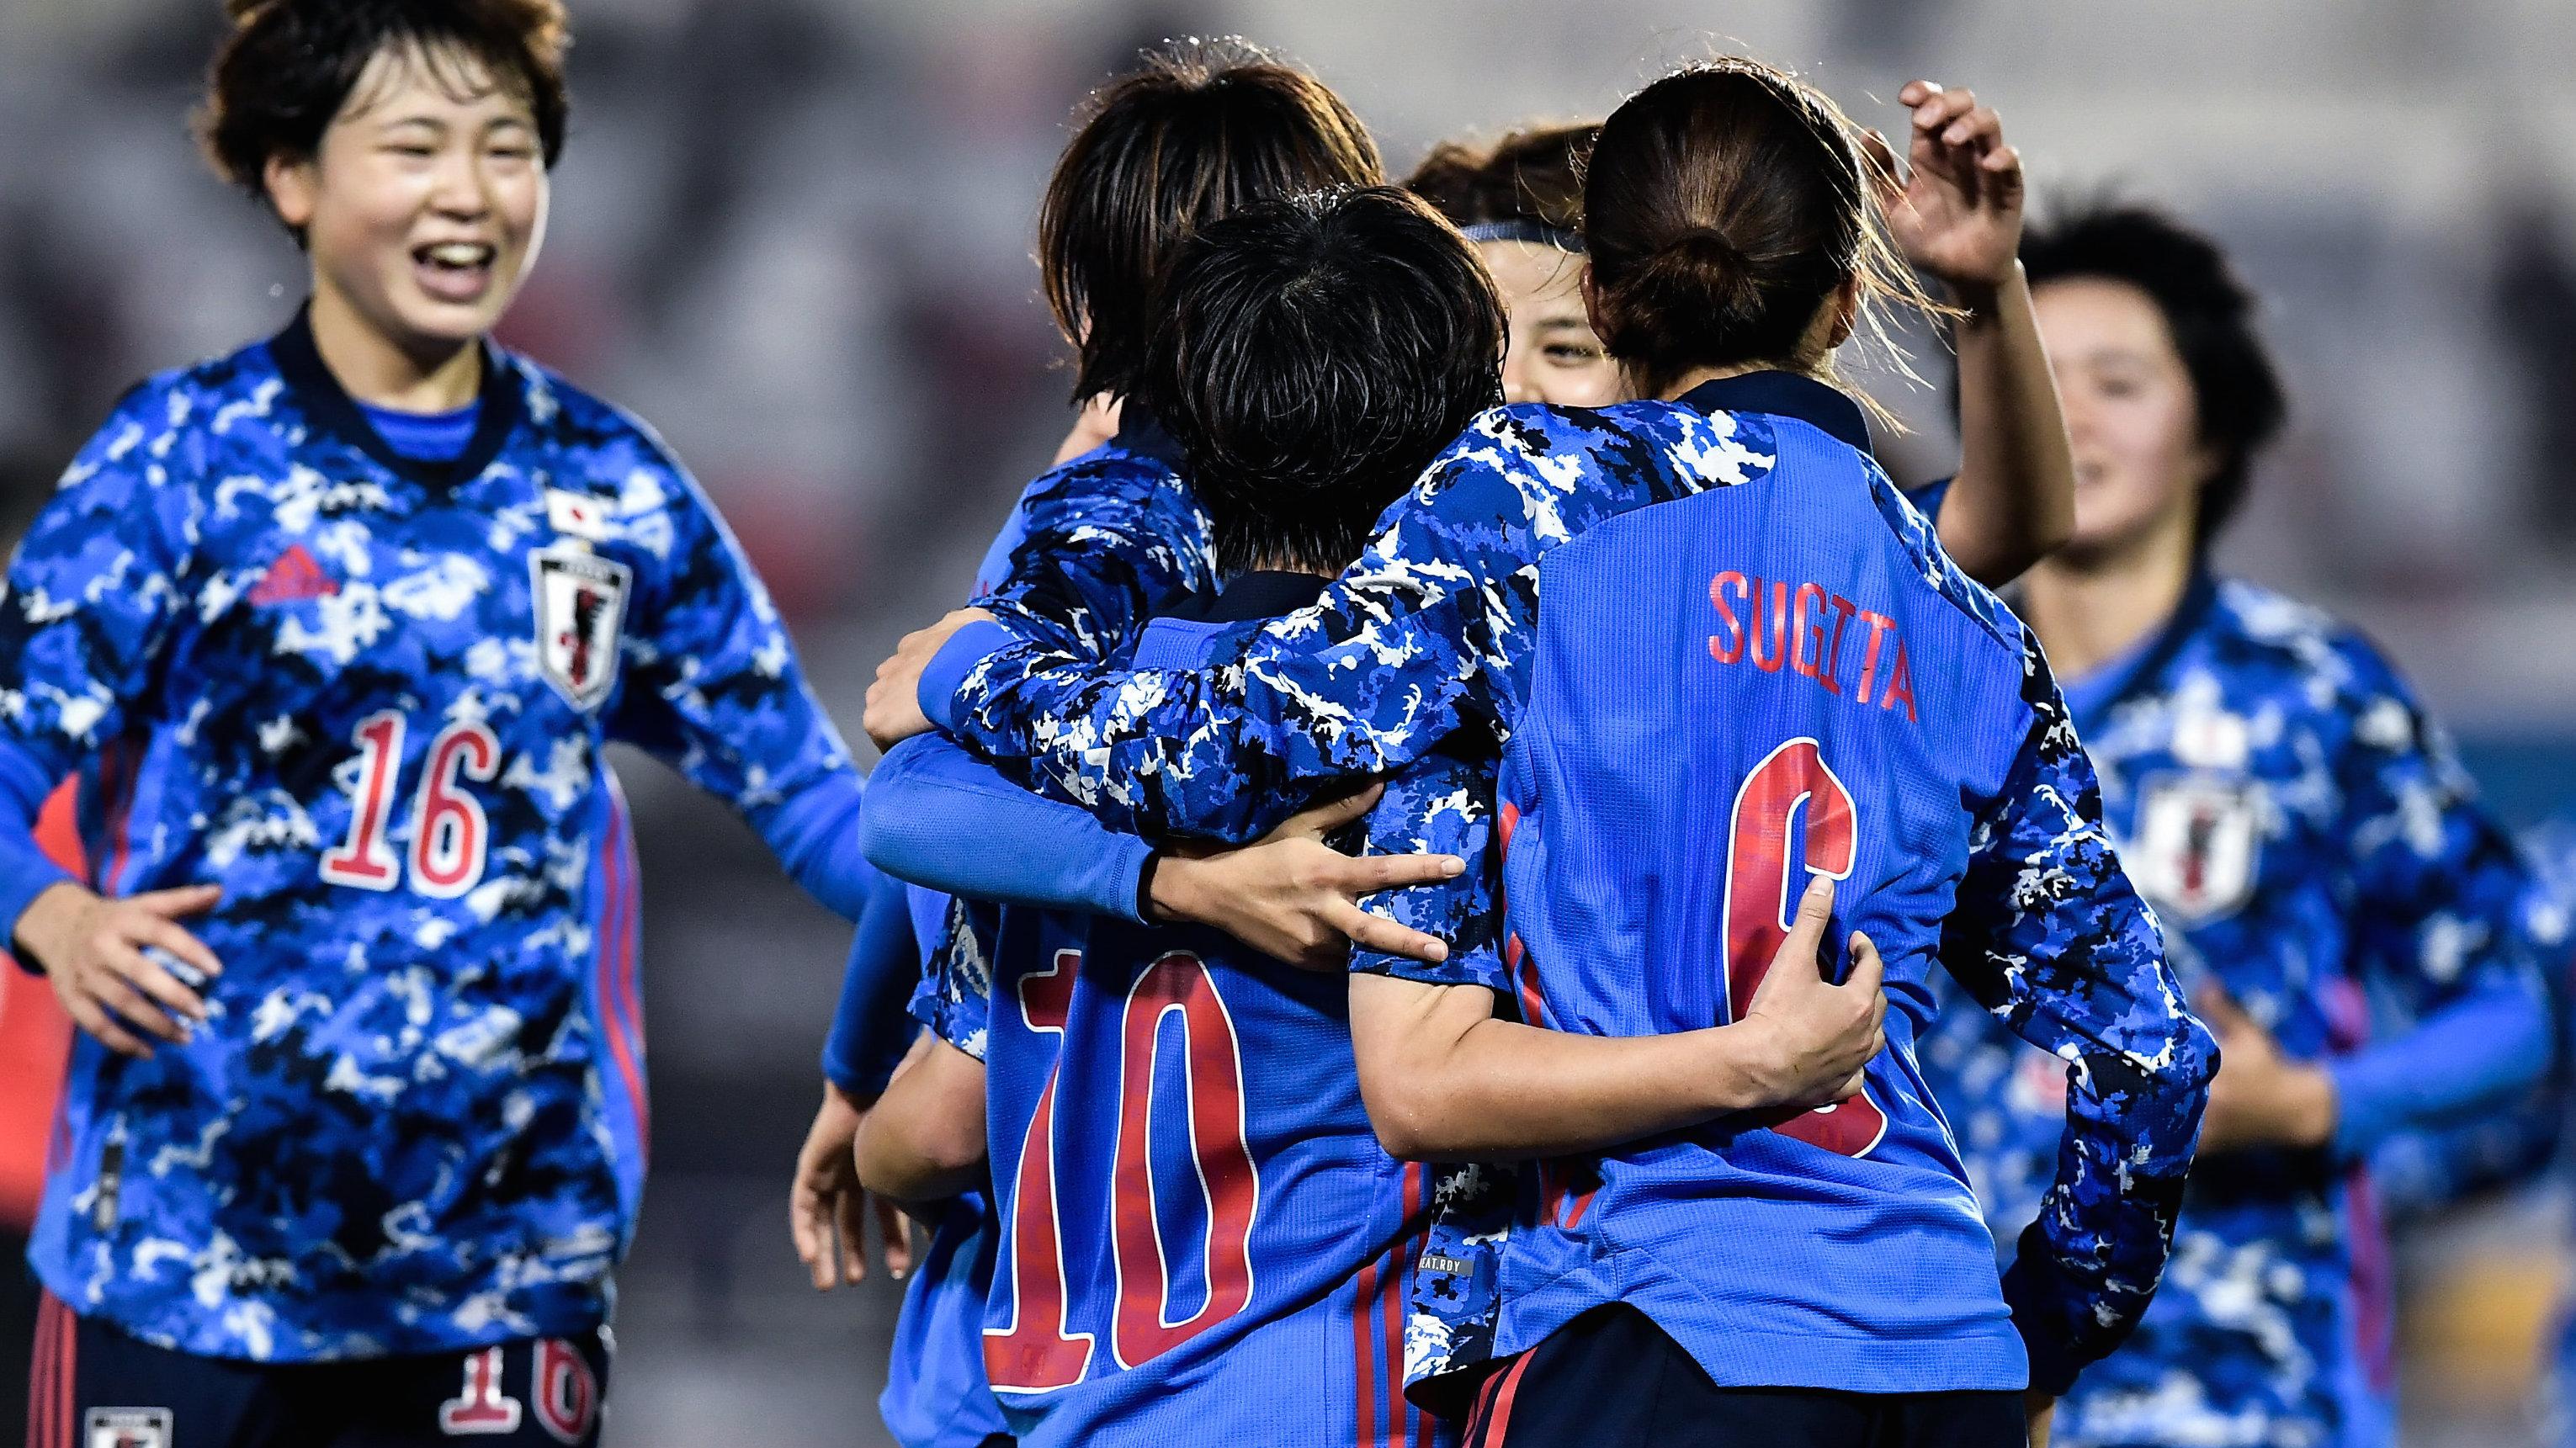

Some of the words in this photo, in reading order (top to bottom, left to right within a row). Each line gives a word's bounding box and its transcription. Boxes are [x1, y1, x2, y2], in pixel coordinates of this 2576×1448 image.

[1708, 570, 1917, 724] SUGITA
[319, 710, 501, 899] 16
[981, 949, 1259, 1394] 10
